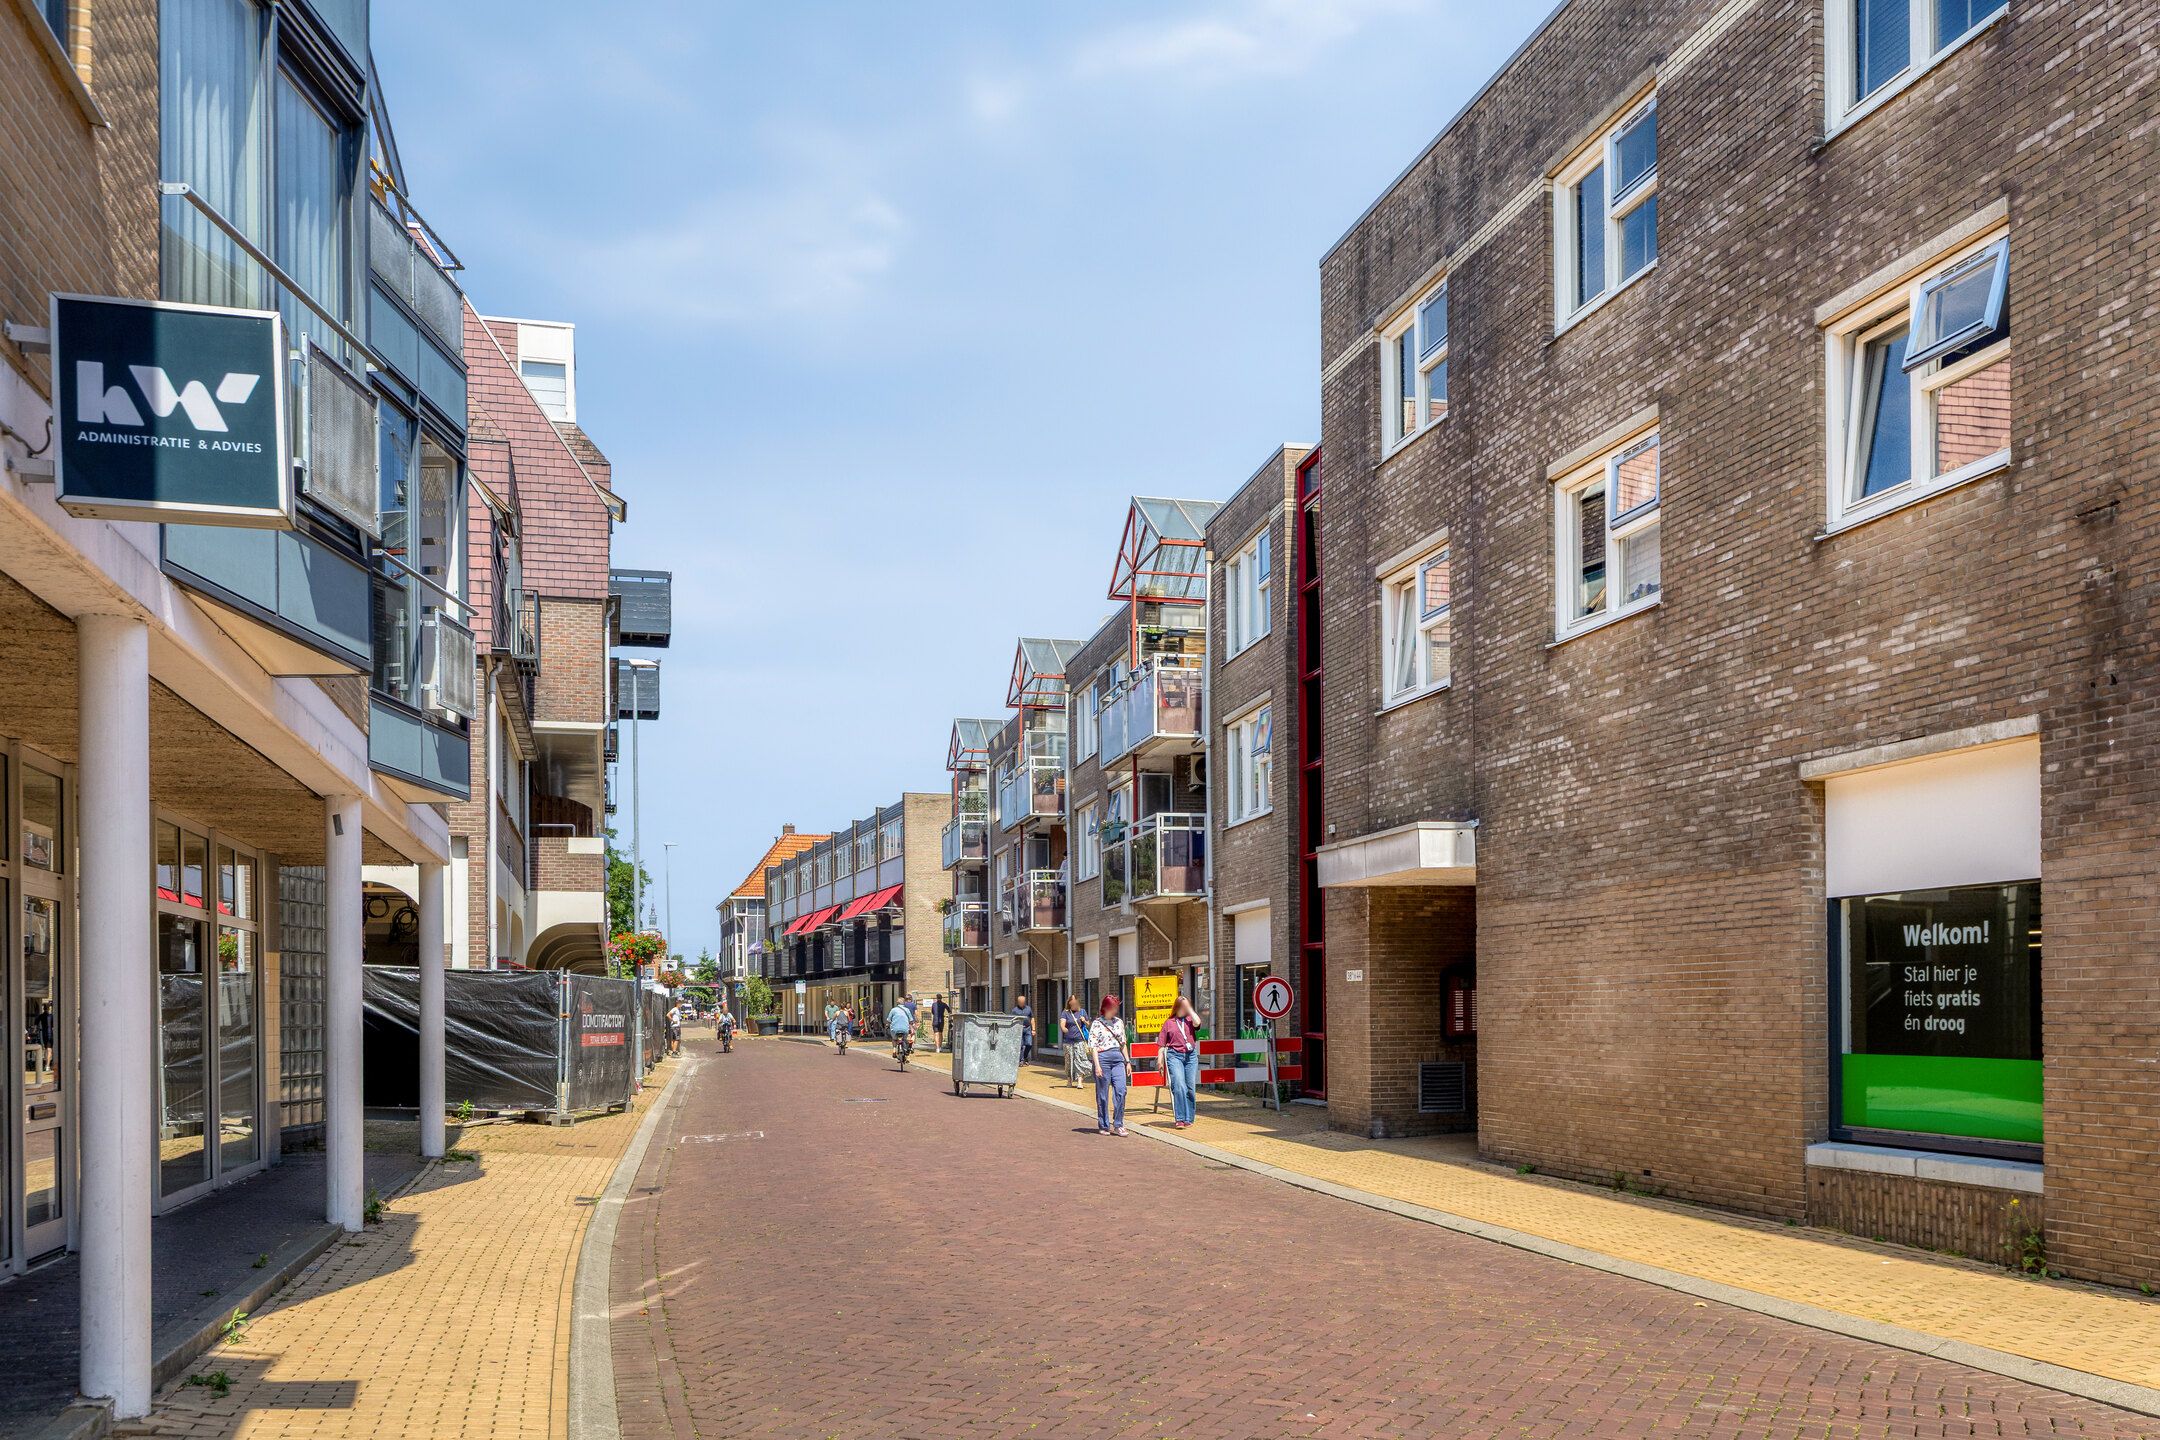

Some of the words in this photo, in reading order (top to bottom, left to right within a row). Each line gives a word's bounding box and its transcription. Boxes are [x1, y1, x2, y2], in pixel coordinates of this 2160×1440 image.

[78, 431, 191, 449] ADMINISTRATIE
[199, 439, 208, 450] &
[212, 441, 262, 453] ADVIES
[1903, 920, 1989, 947] Welkom!
[1904, 966, 1929, 982] Stal
[1933, 966, 1960, 981] hier
[1964, 965, 1977, 985] je
[1904, 990, 1933, 1006] fiets
[1937, 990, 1981, 1010] gratis
[1904, 1014, 1921, 1031] én
[1924, 1015, 1965, 1034] droog
